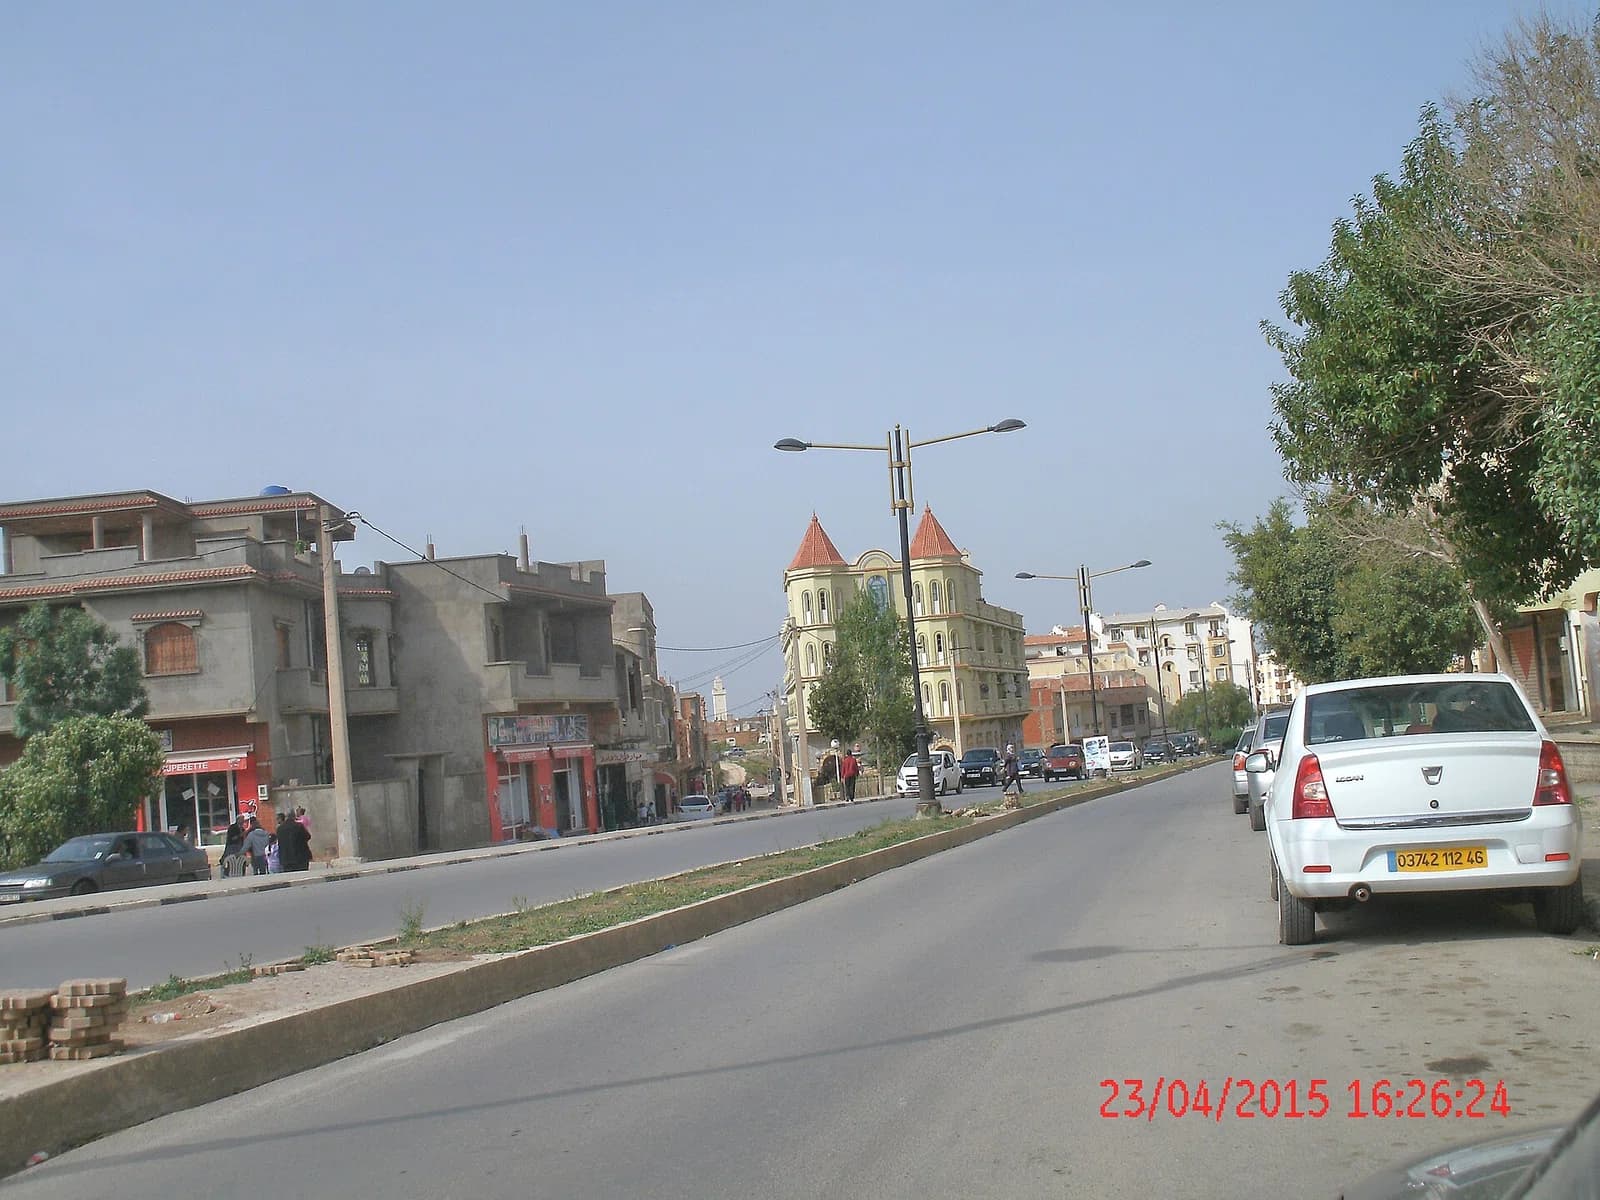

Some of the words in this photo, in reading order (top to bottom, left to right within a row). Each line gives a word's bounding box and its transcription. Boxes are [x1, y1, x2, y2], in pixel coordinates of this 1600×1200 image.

[1335, 774, 1364, 783] LOGAN
[1397, 852, 1439, 868] 03742
[1442, 851, 1463, 866] 112
[1466, 850, 1484, 865] 46
